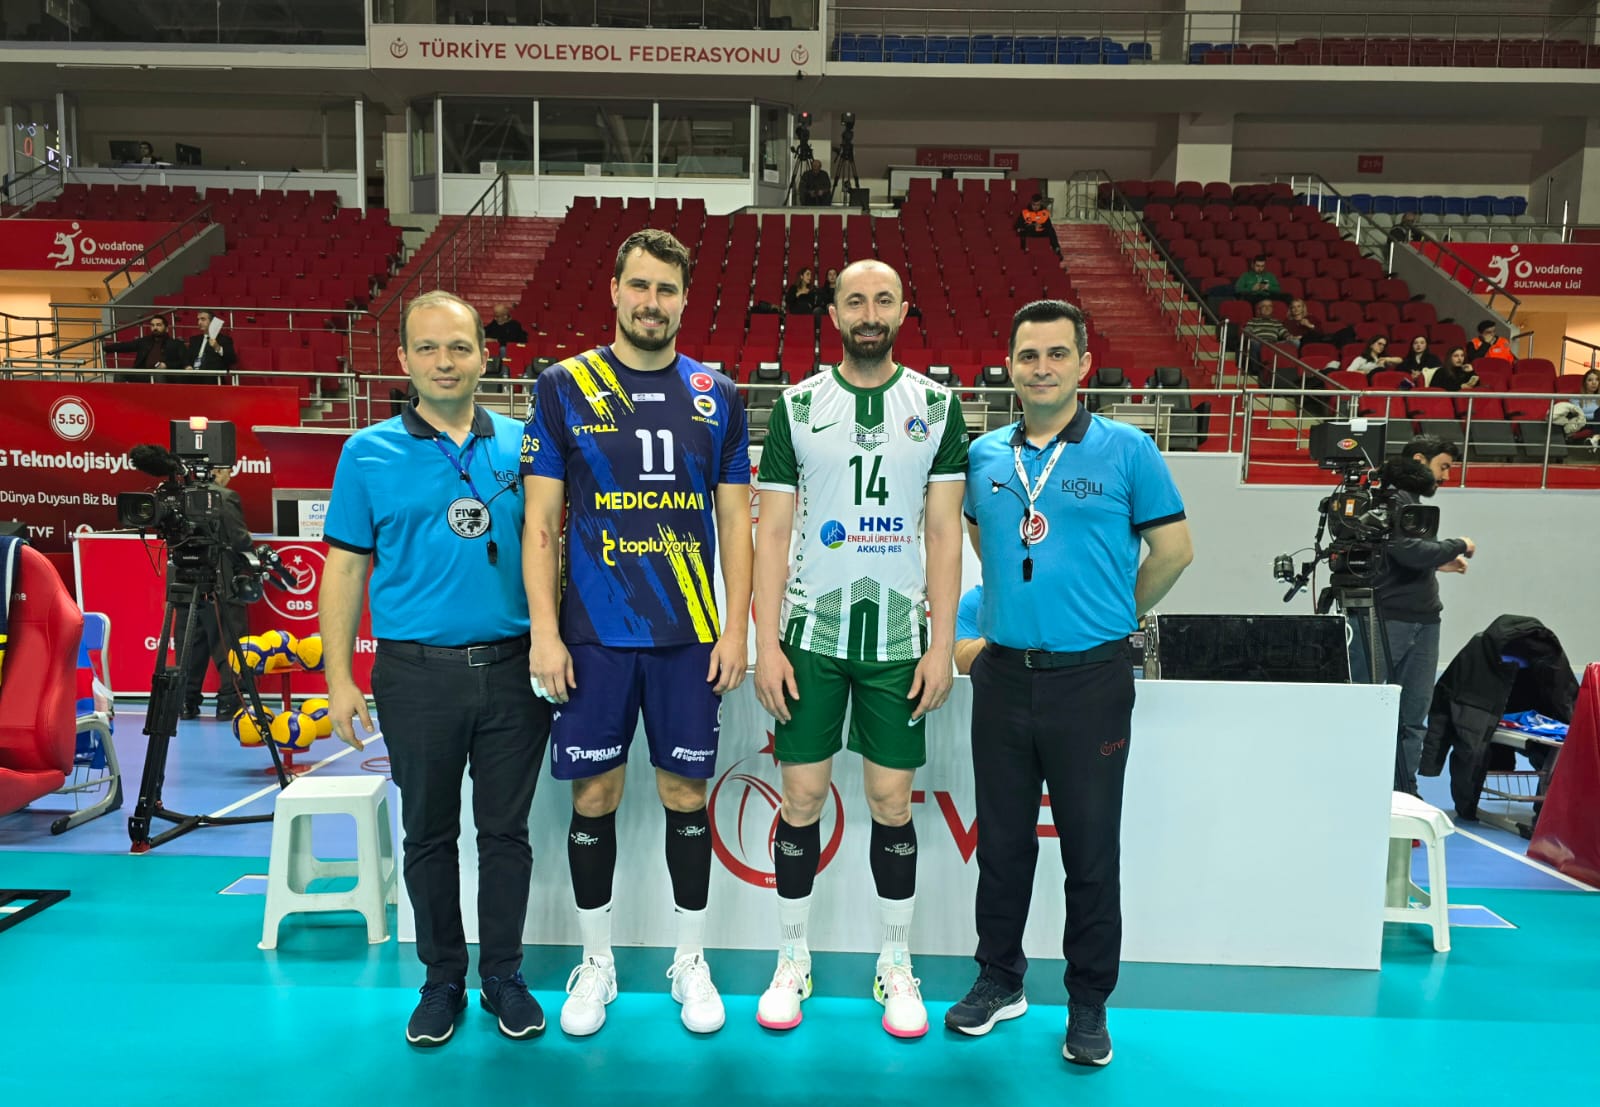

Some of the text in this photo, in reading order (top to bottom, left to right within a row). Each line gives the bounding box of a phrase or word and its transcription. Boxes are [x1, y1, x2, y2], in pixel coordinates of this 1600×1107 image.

[419, 38, 780, 63] TÜRKİYE VOLEYBOL FEDERASYONU
[98, 241, 144, 251] vodafone
[81, 257, 126, 265] SULTANLAR
[1535, 265, 1583, 275] vodafone
[1514, 280, 1561, 289] SULTANLAR
[58, 413, 85, 425] 5.5G
[635, 429, 674, 472] 11
[849, 455, 889, 506] 14
[0, 490, 35, 506] Dünya
[38, 492, 80, 507] Duysun
[83, 493, 99, 505] Biz
[859, 517, 904, 532] HNS
[27, 526, 54, 538] TVF
[847, 535, 873, 543] ENERJİ
[619, 537, 701, 556] topluyoruz
[857, 545, 902, 555] AKKUŞ RES
[286, 600, 313, 611] GDS
